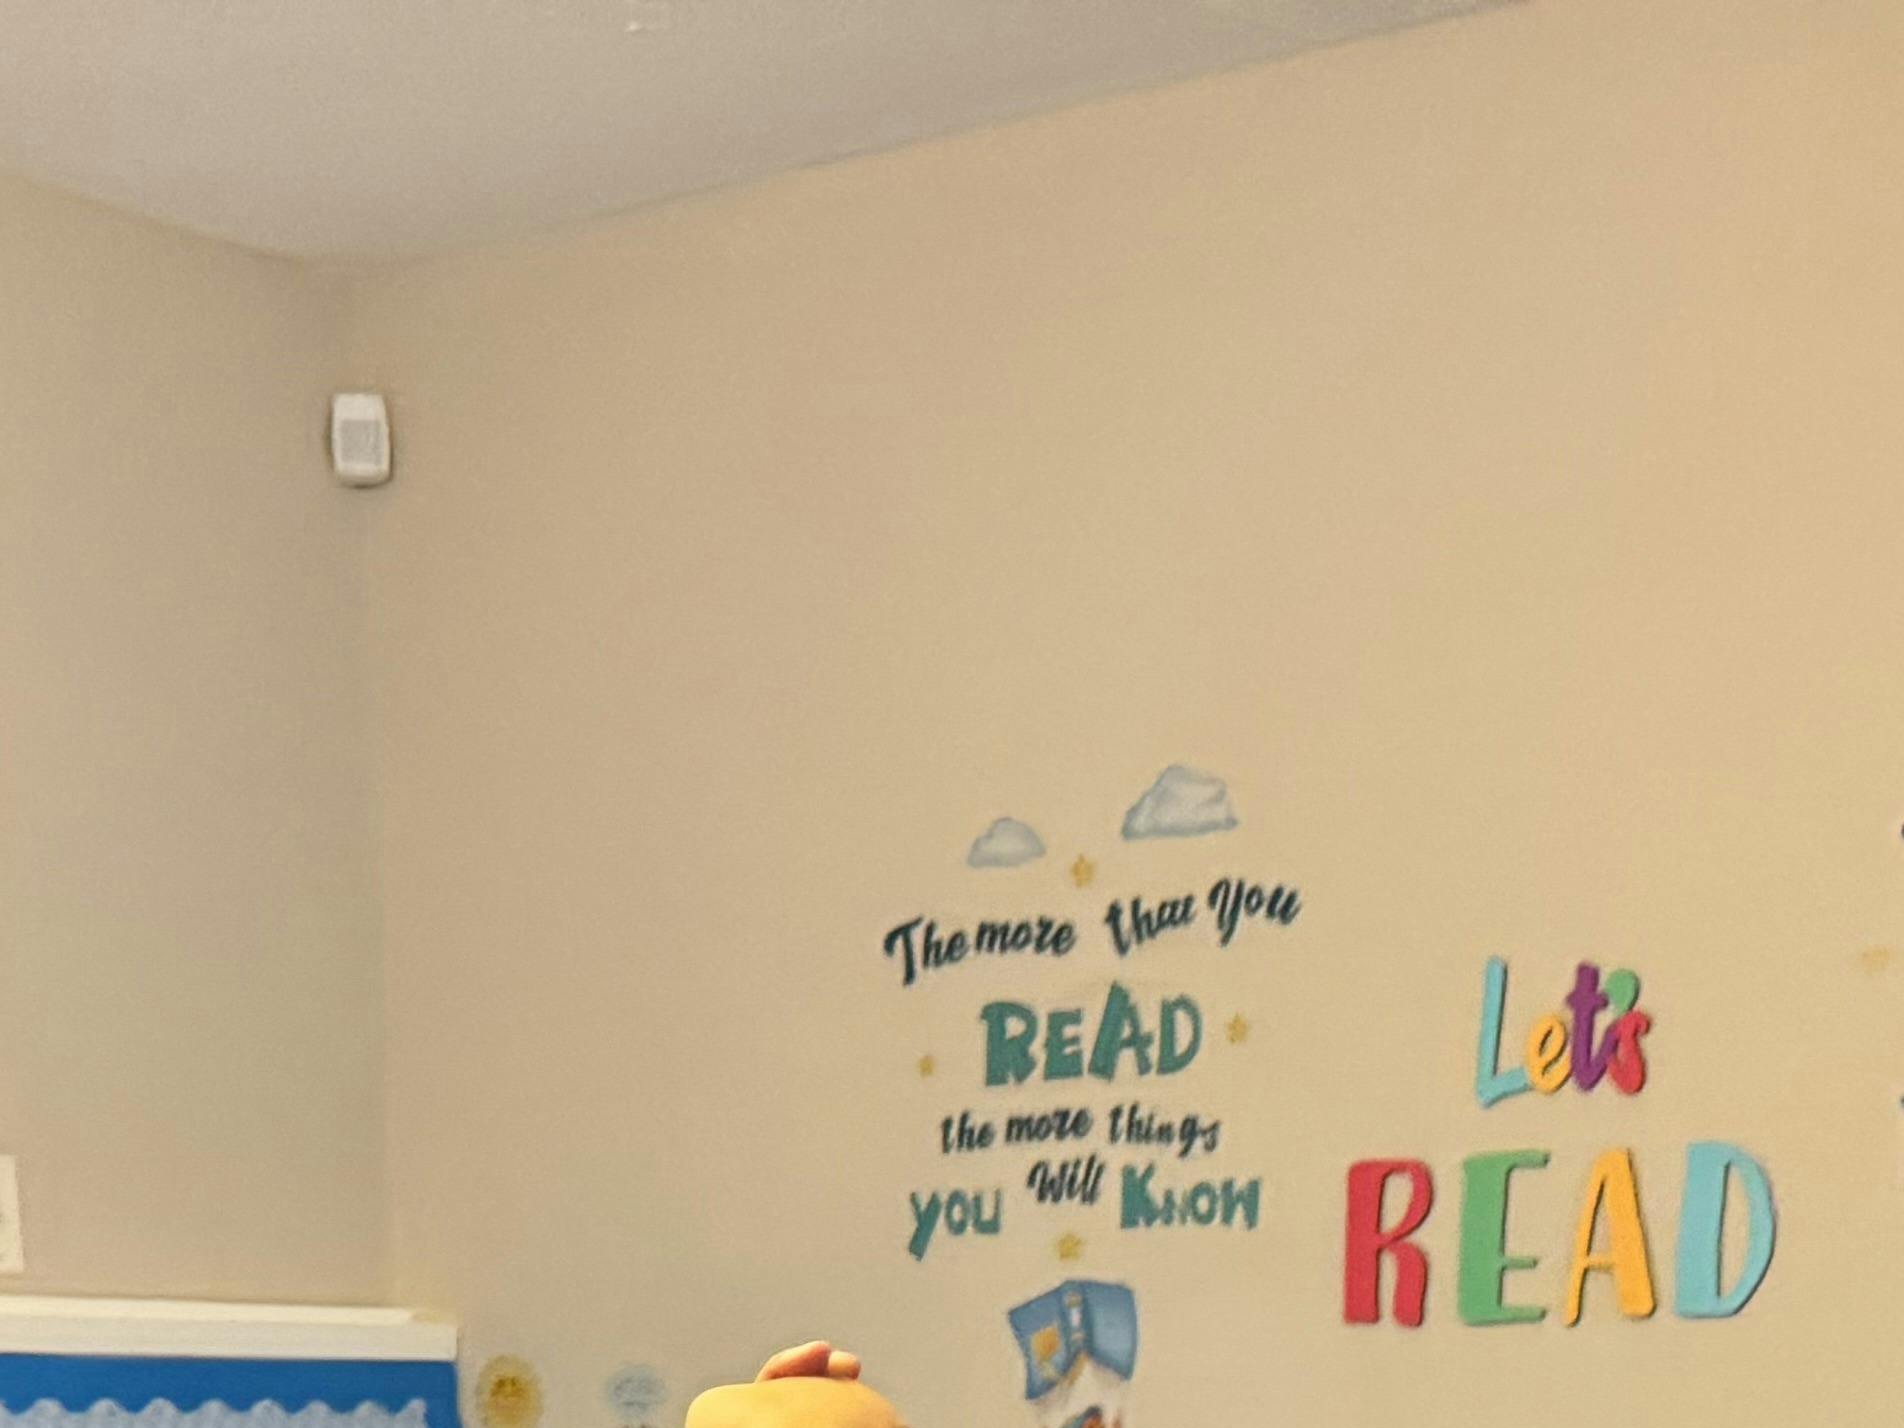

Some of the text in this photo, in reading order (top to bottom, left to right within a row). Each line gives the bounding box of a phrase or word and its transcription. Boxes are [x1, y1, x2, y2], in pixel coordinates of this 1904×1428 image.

[883, 915, 970, 987] The
[975, 914, 1077, 957] more
[1208, 876, 1302, 948] You
[979, 980, 1203, 1088] READ
[1476, 956, 1654, 1110] Let's
[940, 1101, 1222, 1160] the more things
[1342, 1141, 1779, 1332] READ
